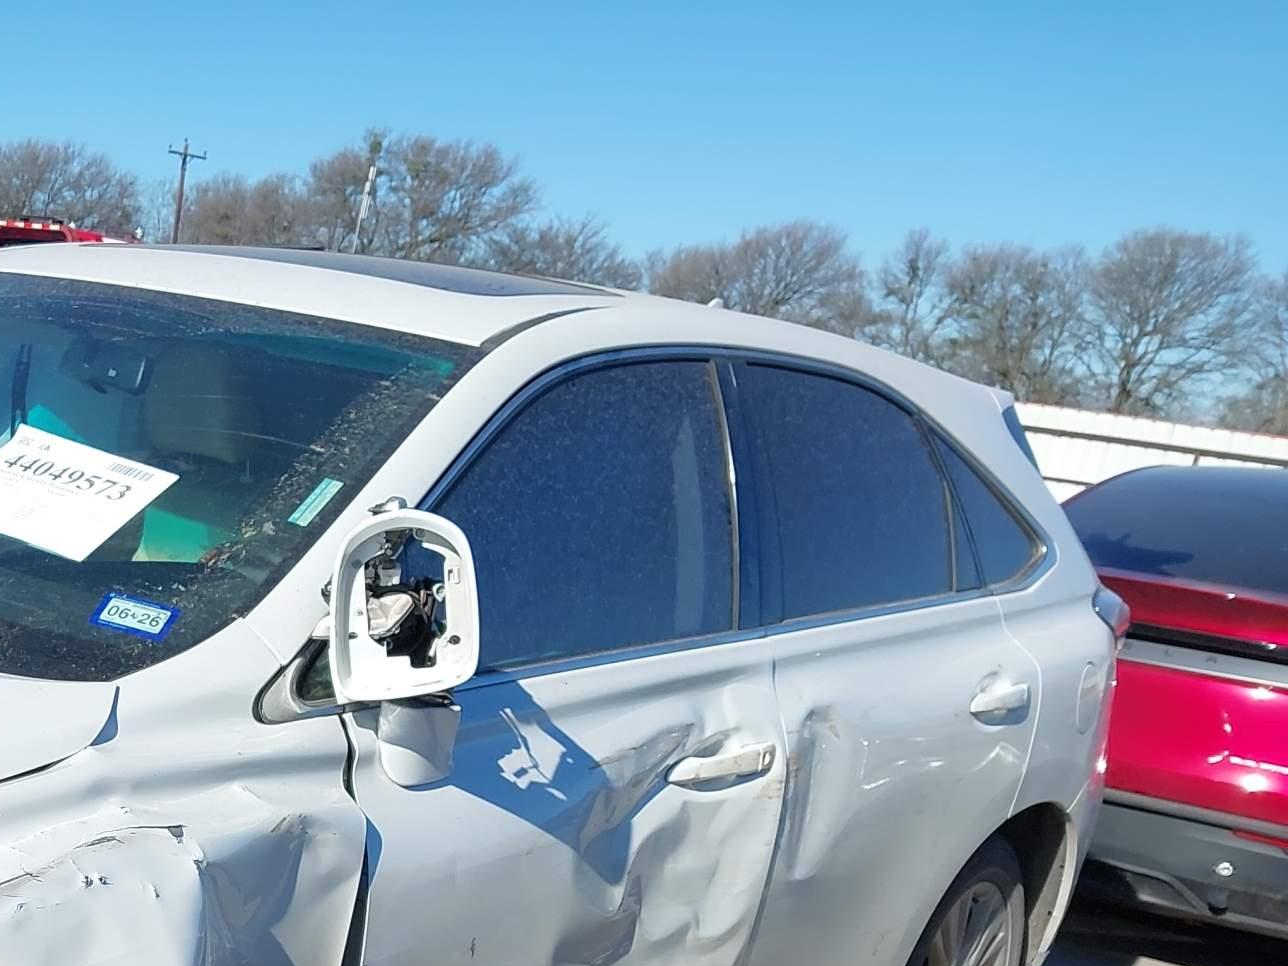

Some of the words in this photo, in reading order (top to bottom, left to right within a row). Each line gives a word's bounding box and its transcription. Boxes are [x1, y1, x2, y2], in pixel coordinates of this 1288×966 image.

[3, 453, 133, 501] 44049573
[107, 605, 132, 619] 06
[137, 613, 162, 628] 26
